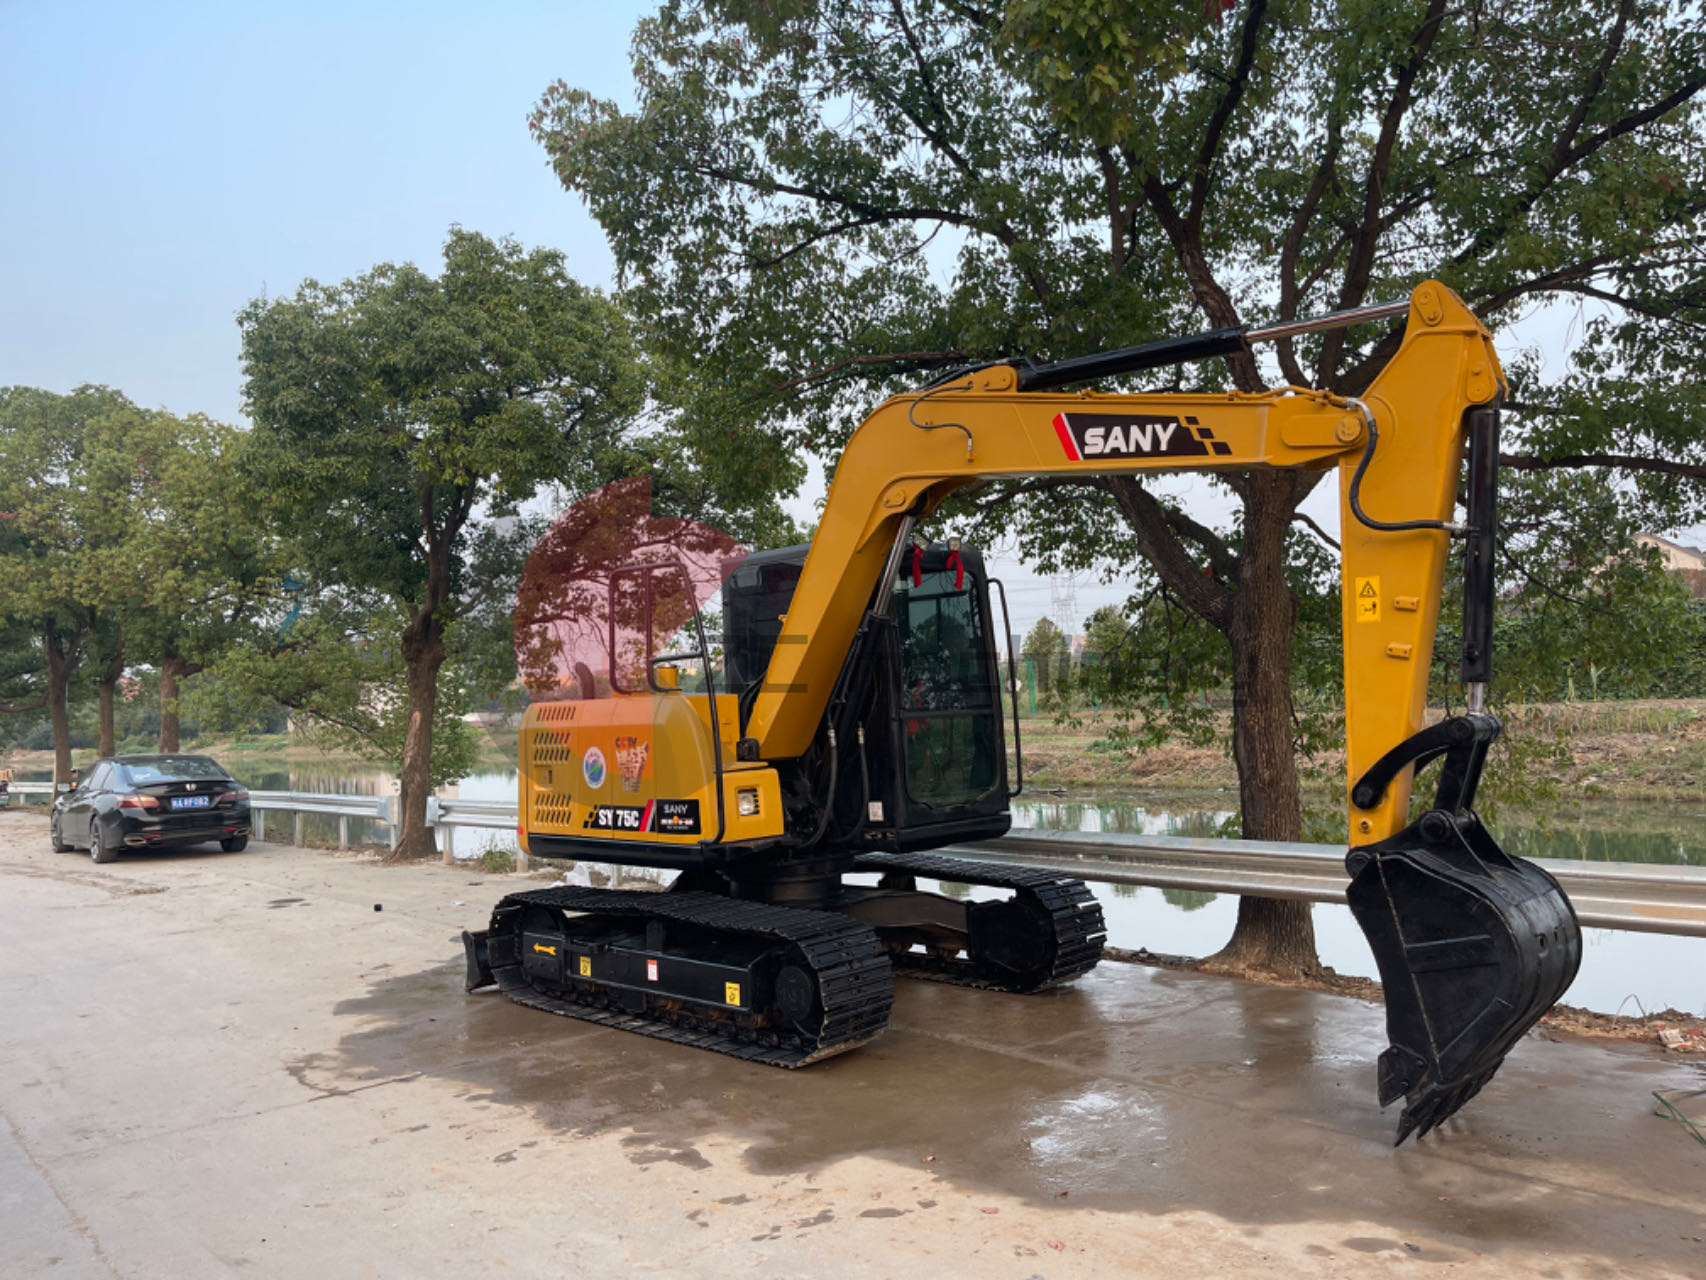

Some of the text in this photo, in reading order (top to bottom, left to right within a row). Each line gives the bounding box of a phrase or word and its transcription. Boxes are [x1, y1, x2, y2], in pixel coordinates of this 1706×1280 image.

[1084, 423, 1177, 455] SANY
[598, 808, 639, 827] SY 75C
[664, 803, 688, 814] SANY
